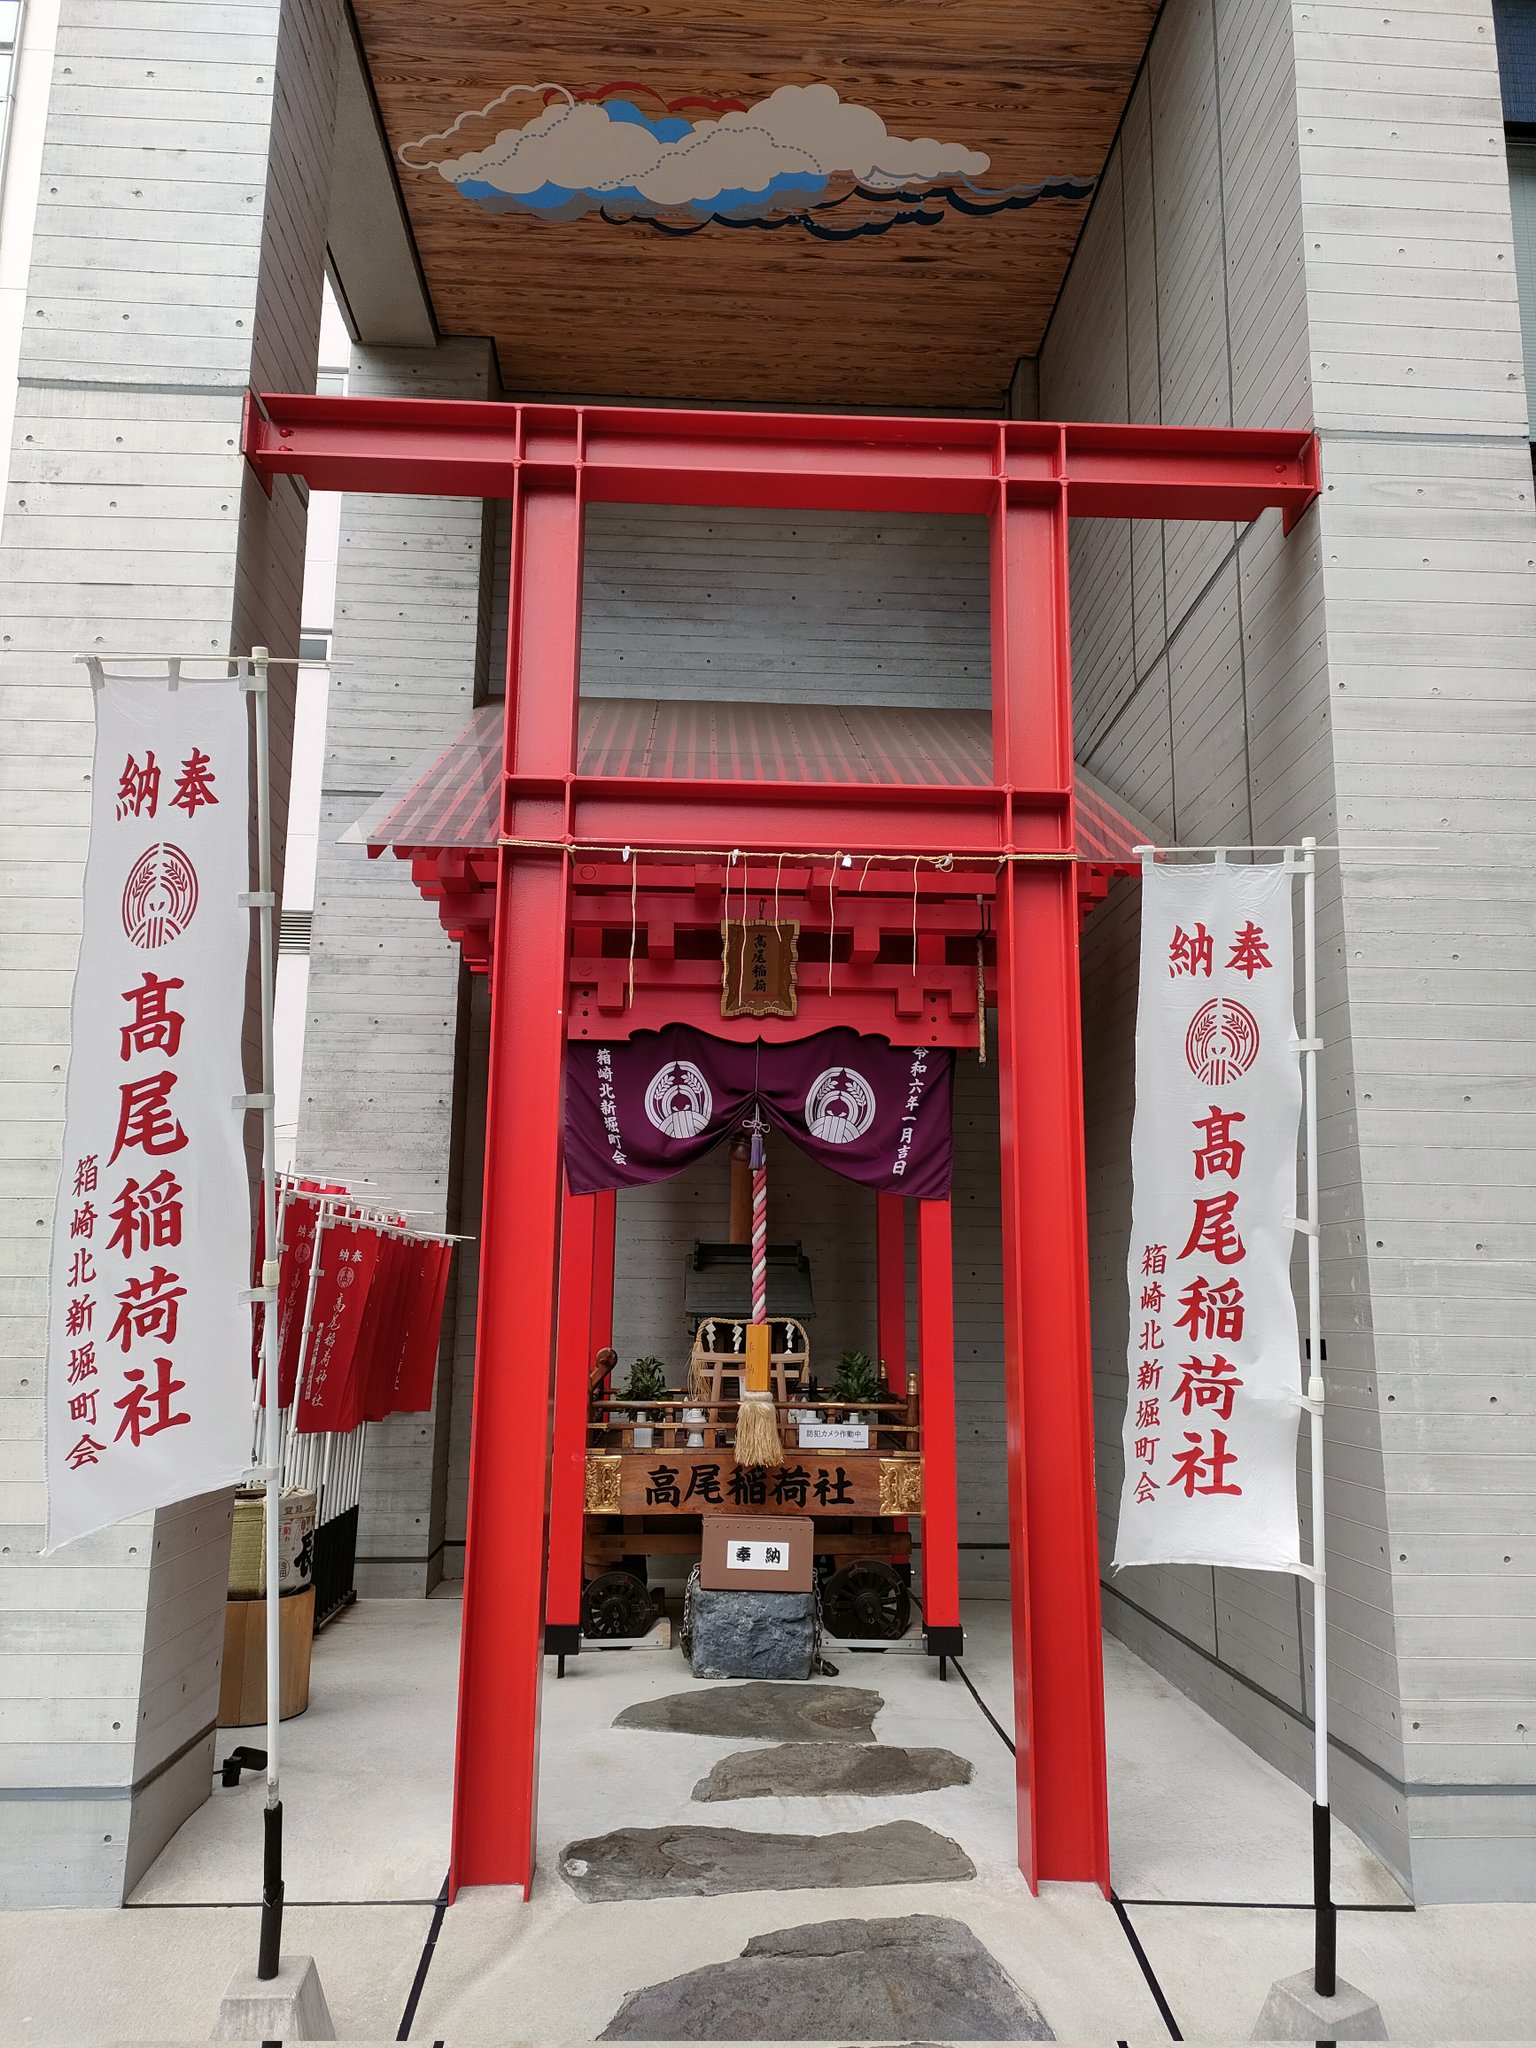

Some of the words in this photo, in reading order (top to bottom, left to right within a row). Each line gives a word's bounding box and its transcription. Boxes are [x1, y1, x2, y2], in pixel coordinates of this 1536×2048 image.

[597, 1048, 627, 1165] 箱崎北新堀町会
[892, 1047, 929, 1176] 令和六年一月吉日
[65, 1154, 106, 1470] 箱崎北新堀町会
[1133, 1244, 1168, 1504] 箱崎北新堀町会
[806, 1429, 861, 1438] 防犯カメラ作動中
